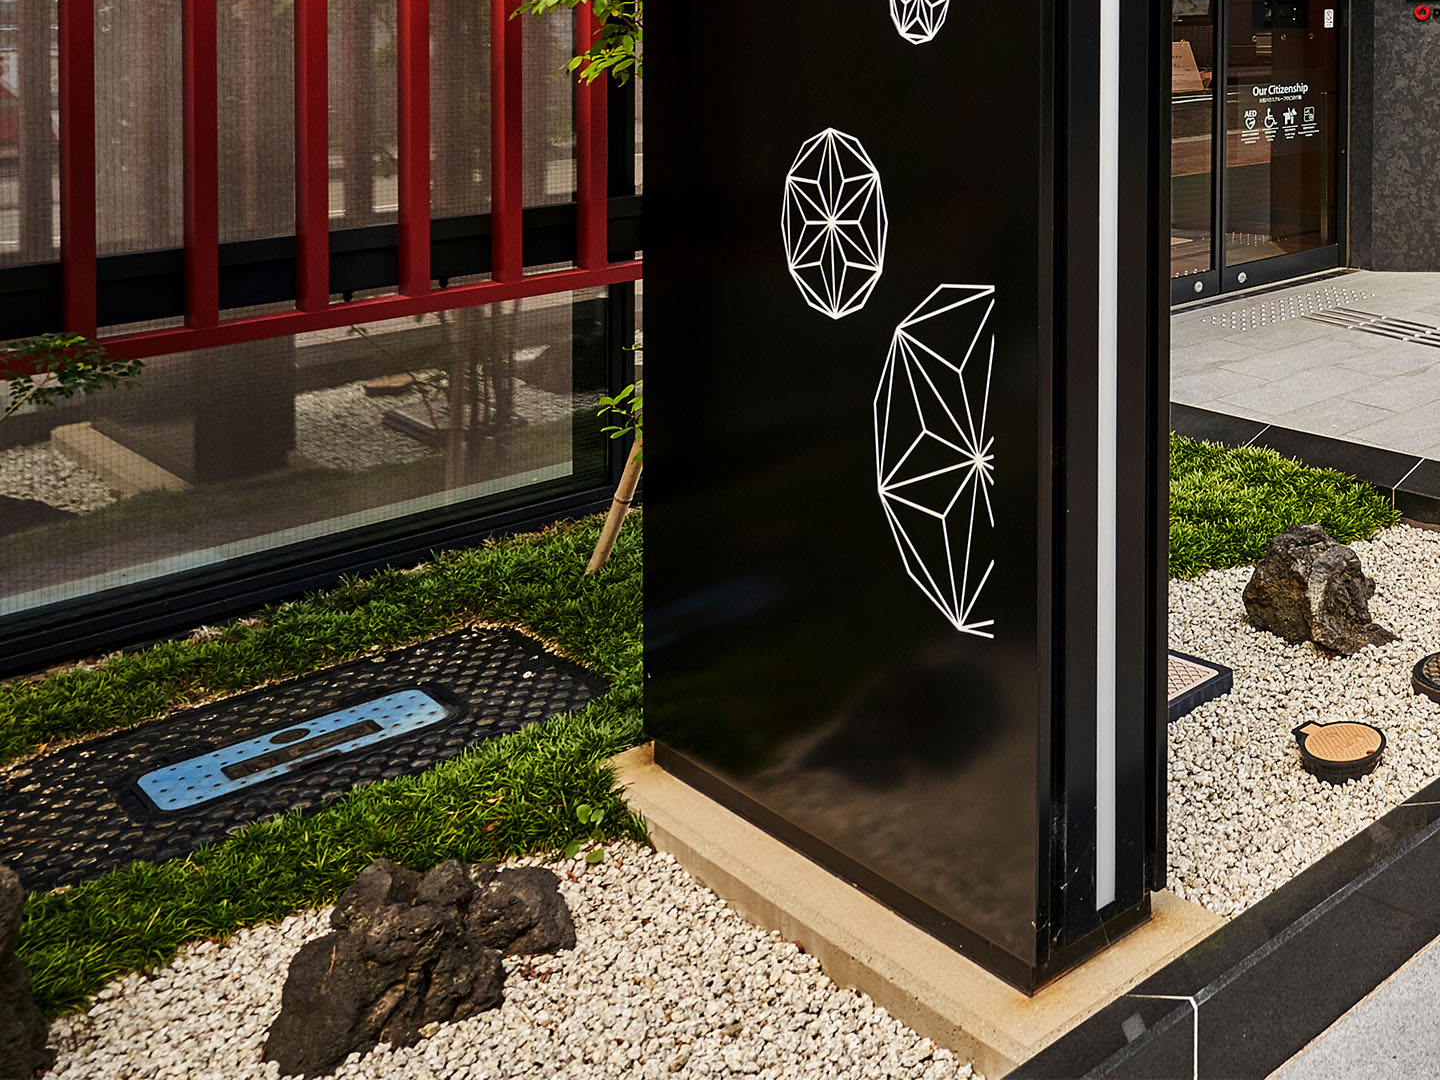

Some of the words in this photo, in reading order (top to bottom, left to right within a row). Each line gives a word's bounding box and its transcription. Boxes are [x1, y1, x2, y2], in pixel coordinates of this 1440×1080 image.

[1252, 86, 1268, 96] Our
[1268, 83, 1308, 95] Citizenship
[1244, 110, 1257, 118] AED
